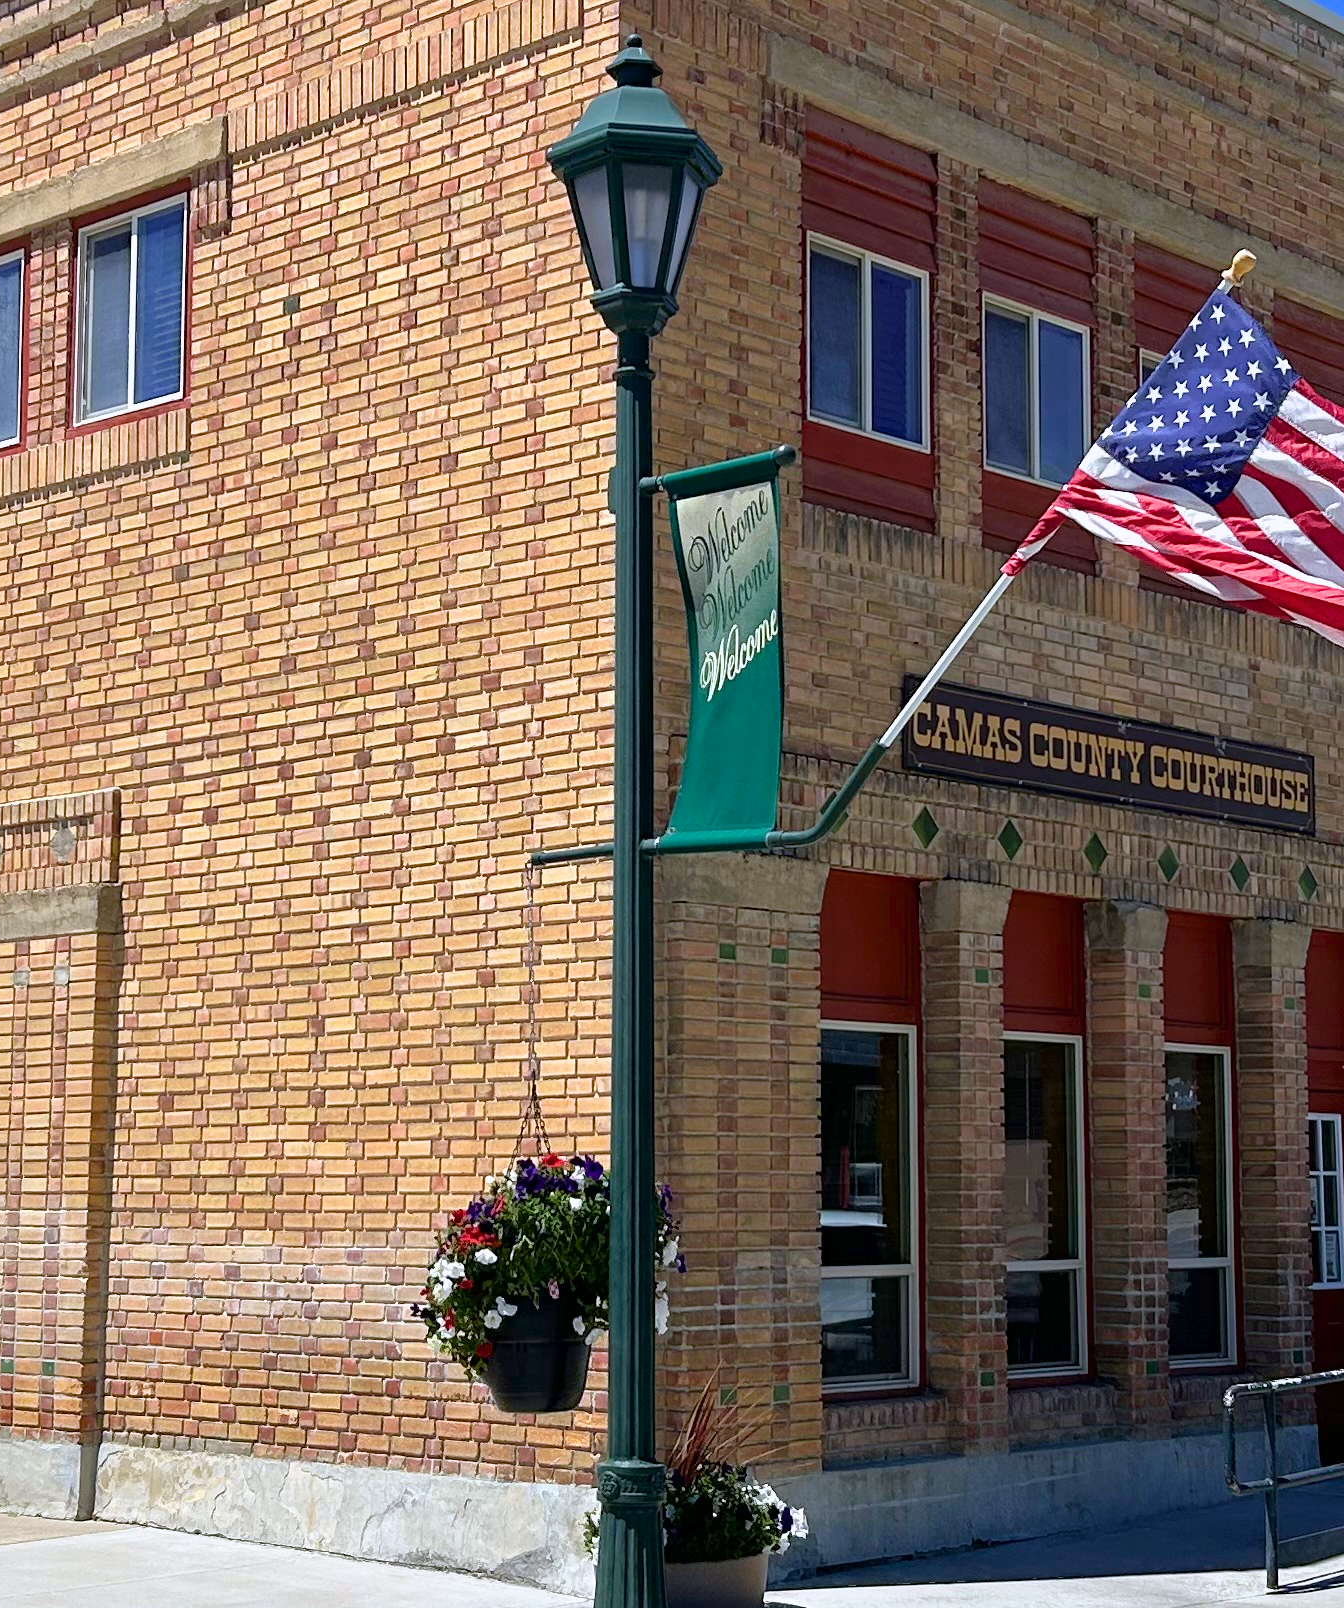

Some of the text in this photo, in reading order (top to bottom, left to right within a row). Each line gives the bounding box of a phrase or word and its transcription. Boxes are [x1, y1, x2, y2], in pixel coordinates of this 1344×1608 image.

[688, 489, 768, 586] Welcome
[699, 548, 776, 642] Welcome
[699, 608, 779, 702] Welcome
[912, 702, 1309, 813] CAMAS COUNTY COURTHOUSE
